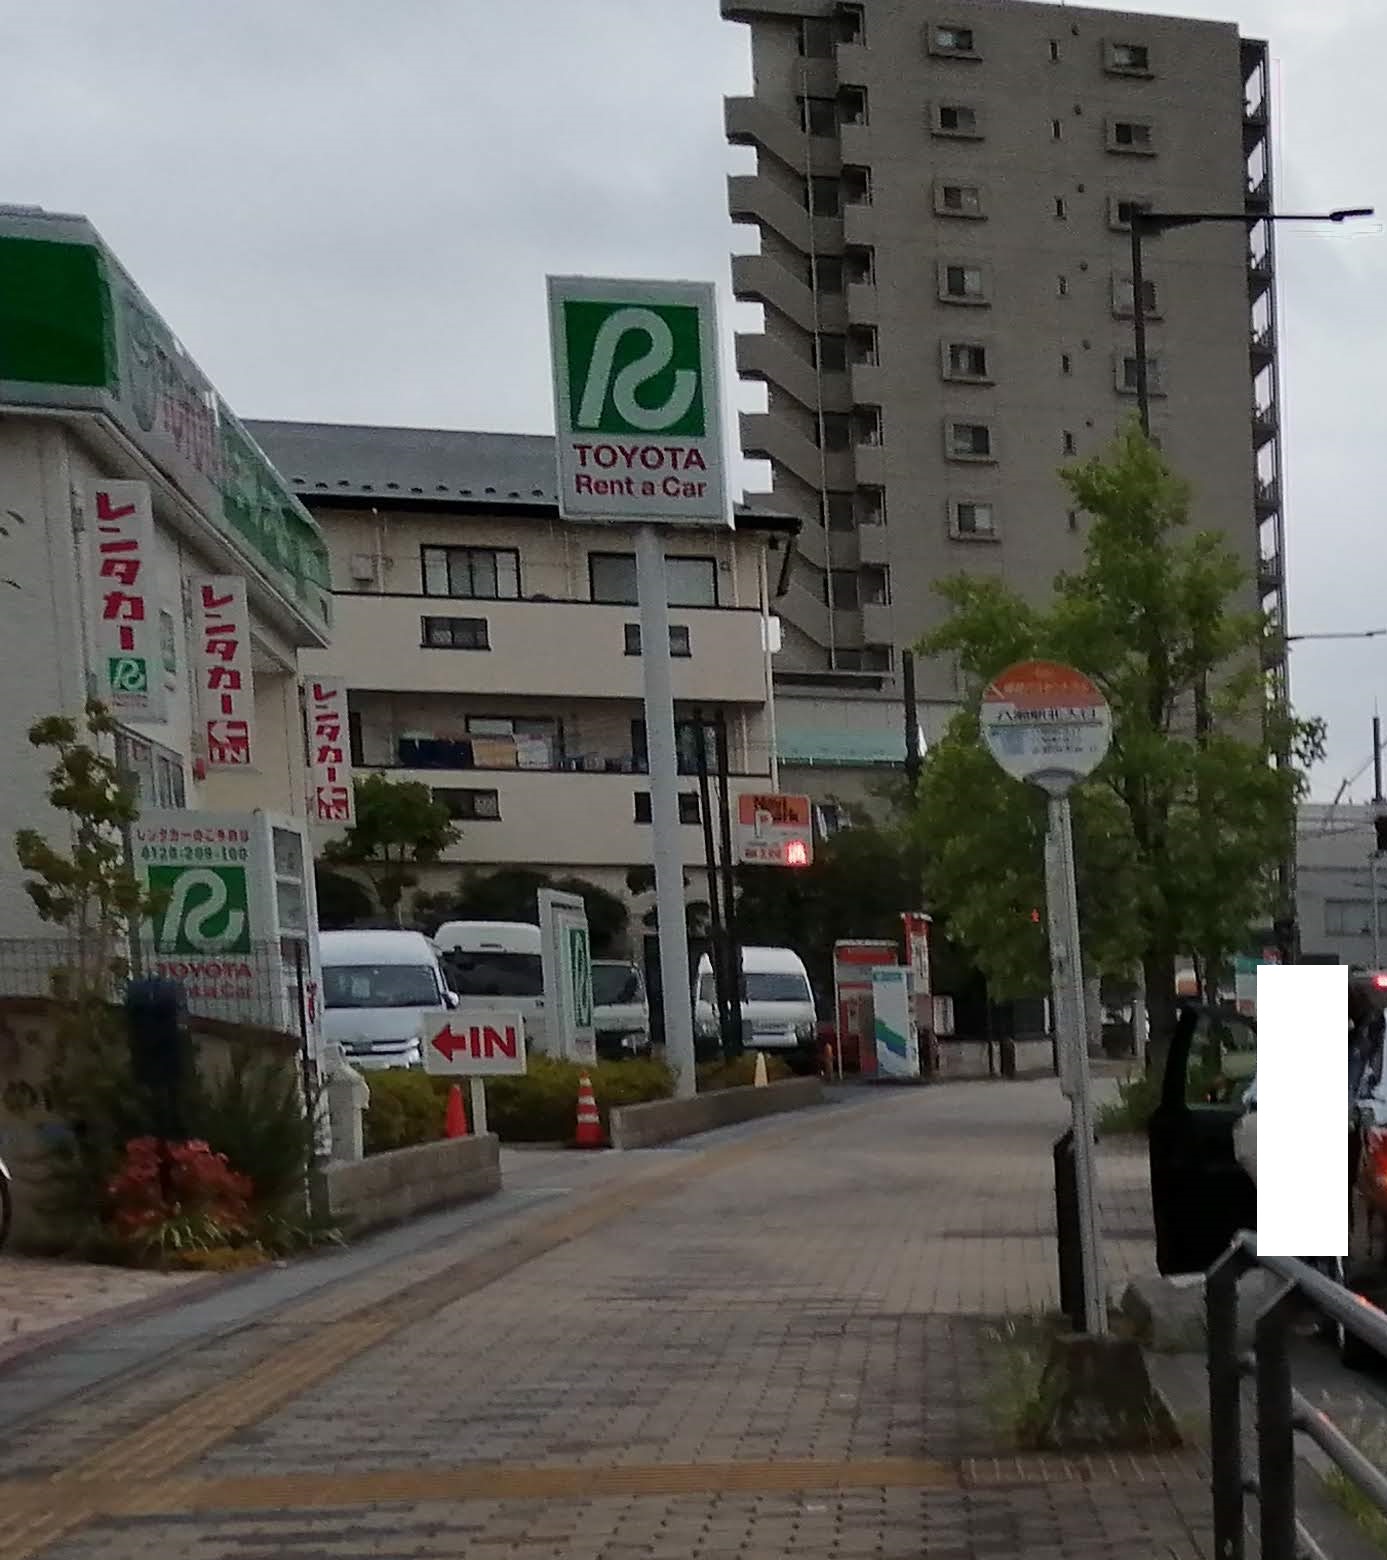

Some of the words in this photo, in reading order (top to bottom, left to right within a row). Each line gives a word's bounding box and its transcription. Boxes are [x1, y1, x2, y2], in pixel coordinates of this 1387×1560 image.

[572, 443, 707, 471] TOYOTA
[575, 473, 635, 496] Rent
[641, 479, 656, 496] a
[662, 476, 707, 497] Car
[95, 490, 146, 651] レンタカー
[201, 584, 242, 716] レンタカー
[312, 682, 343, 783] レンタカー
[469, 1026, 517, 1058] IN
